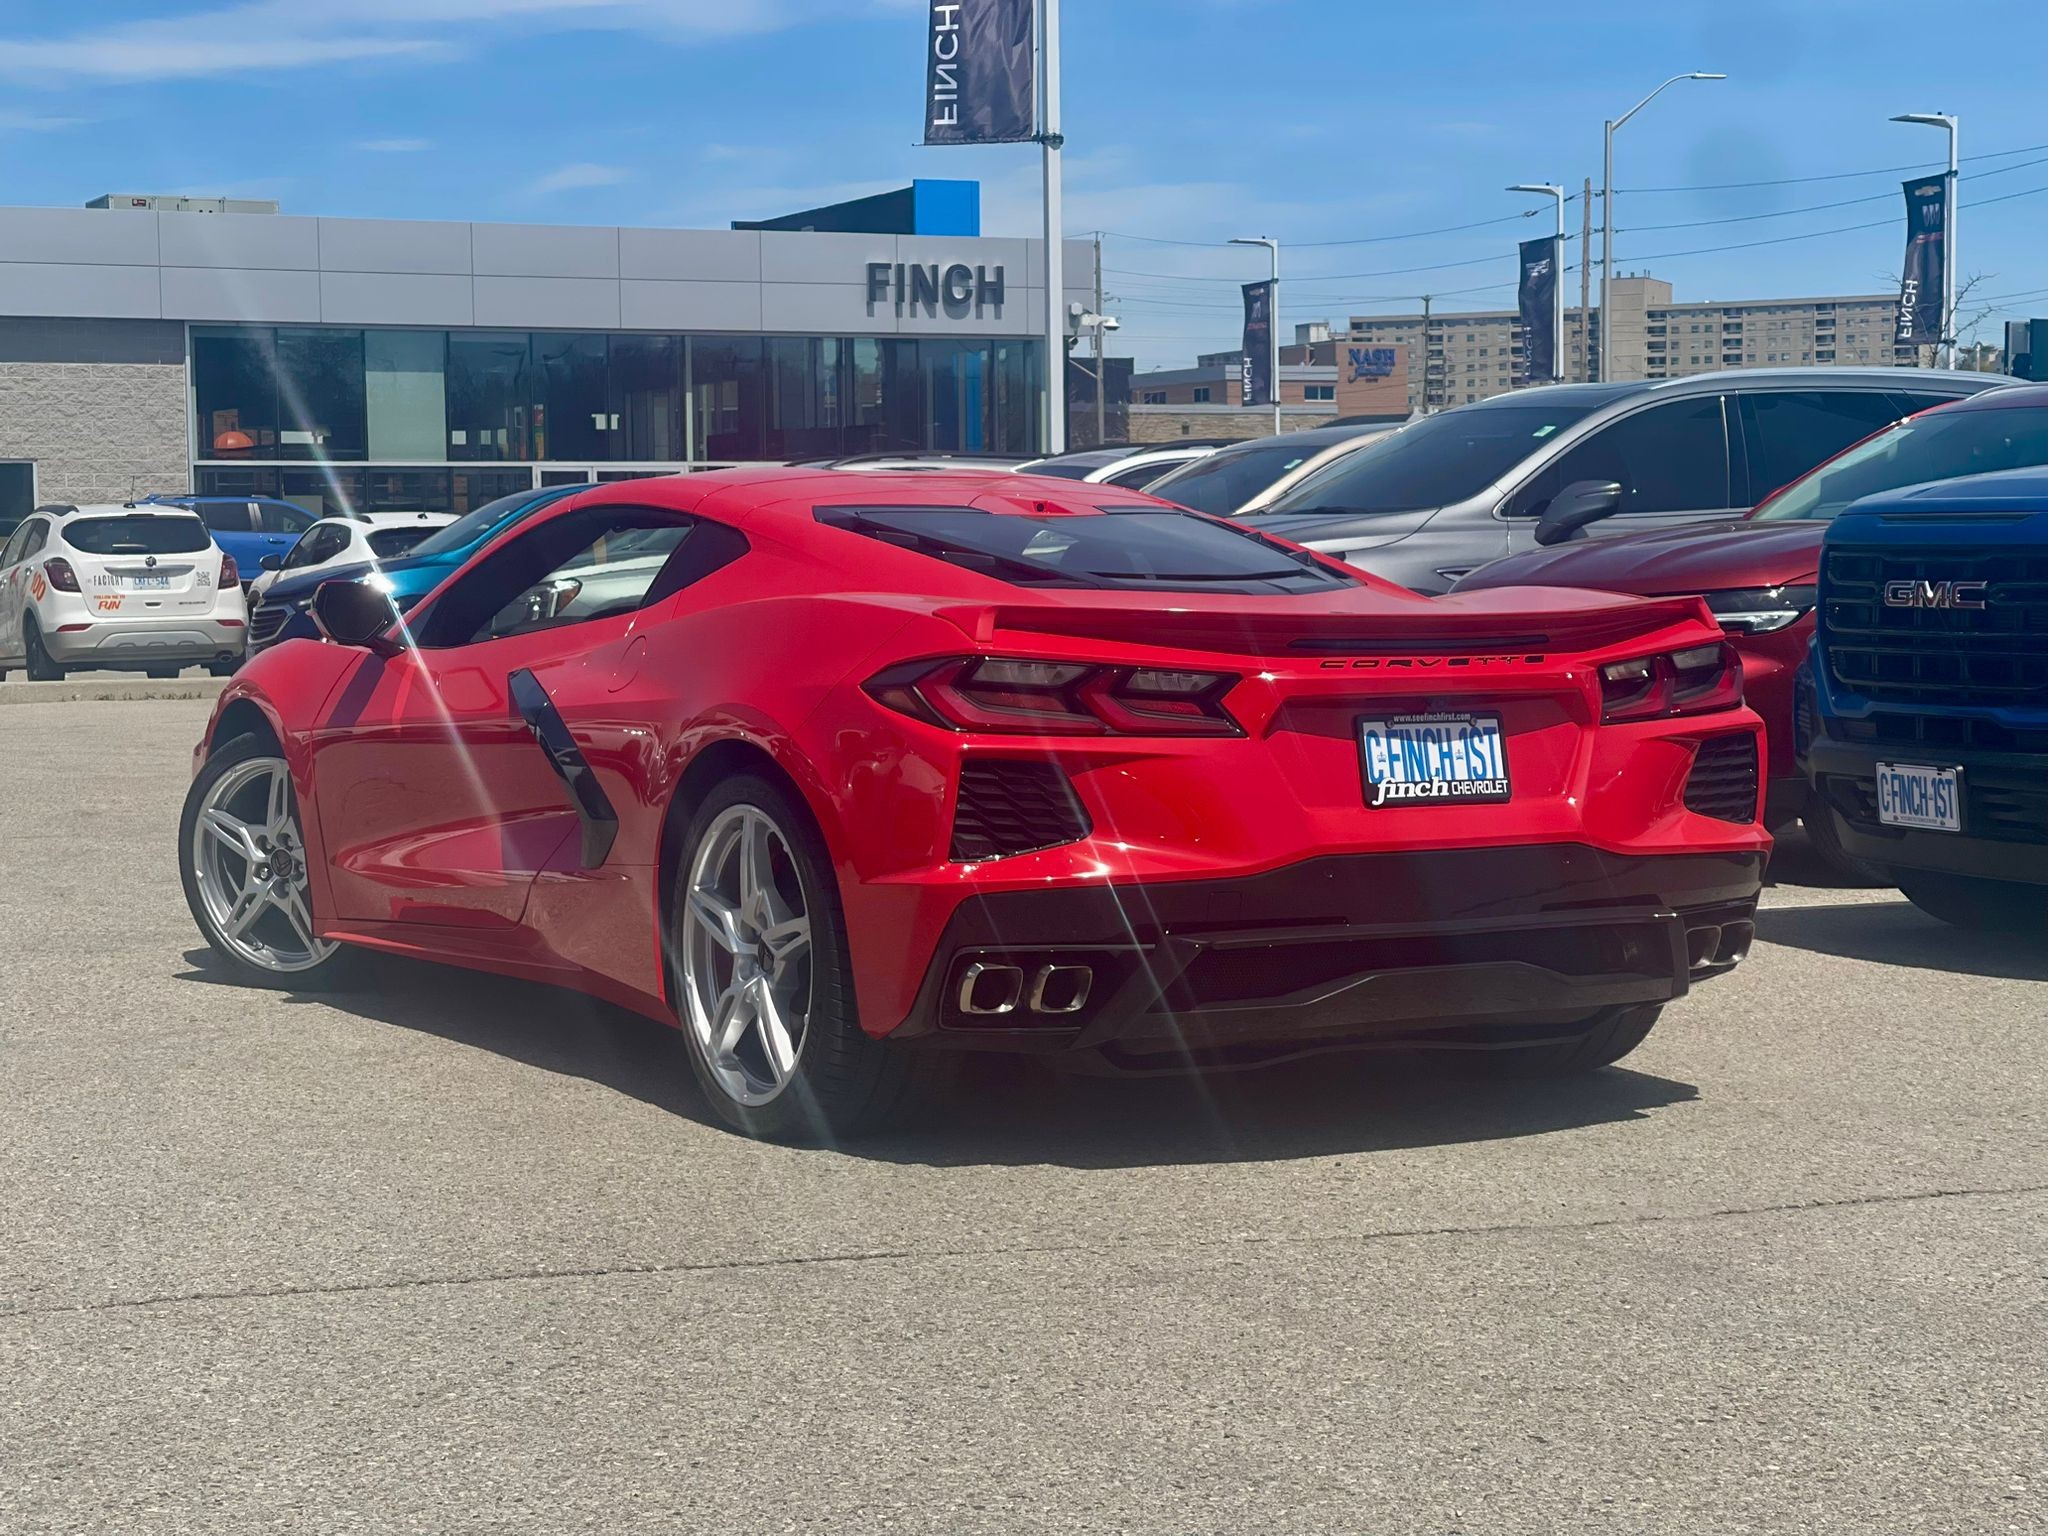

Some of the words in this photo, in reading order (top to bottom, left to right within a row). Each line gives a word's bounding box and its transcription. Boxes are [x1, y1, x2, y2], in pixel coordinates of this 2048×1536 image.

[866, 262, 1005, 305] FINCH
[1348, 347, 1396, 366] NASH
[1884, 579, 1988, 610] GMC
[98, 600, 121, 610] FUN
[1319, 654, 1545, 669] CORVETTE
[1393, 711, 1471, 723] www.seefinchfirst.com
[1371, 776, 1450, 806] finch
[1451, 779, 1509, 796] CHEVROLET
